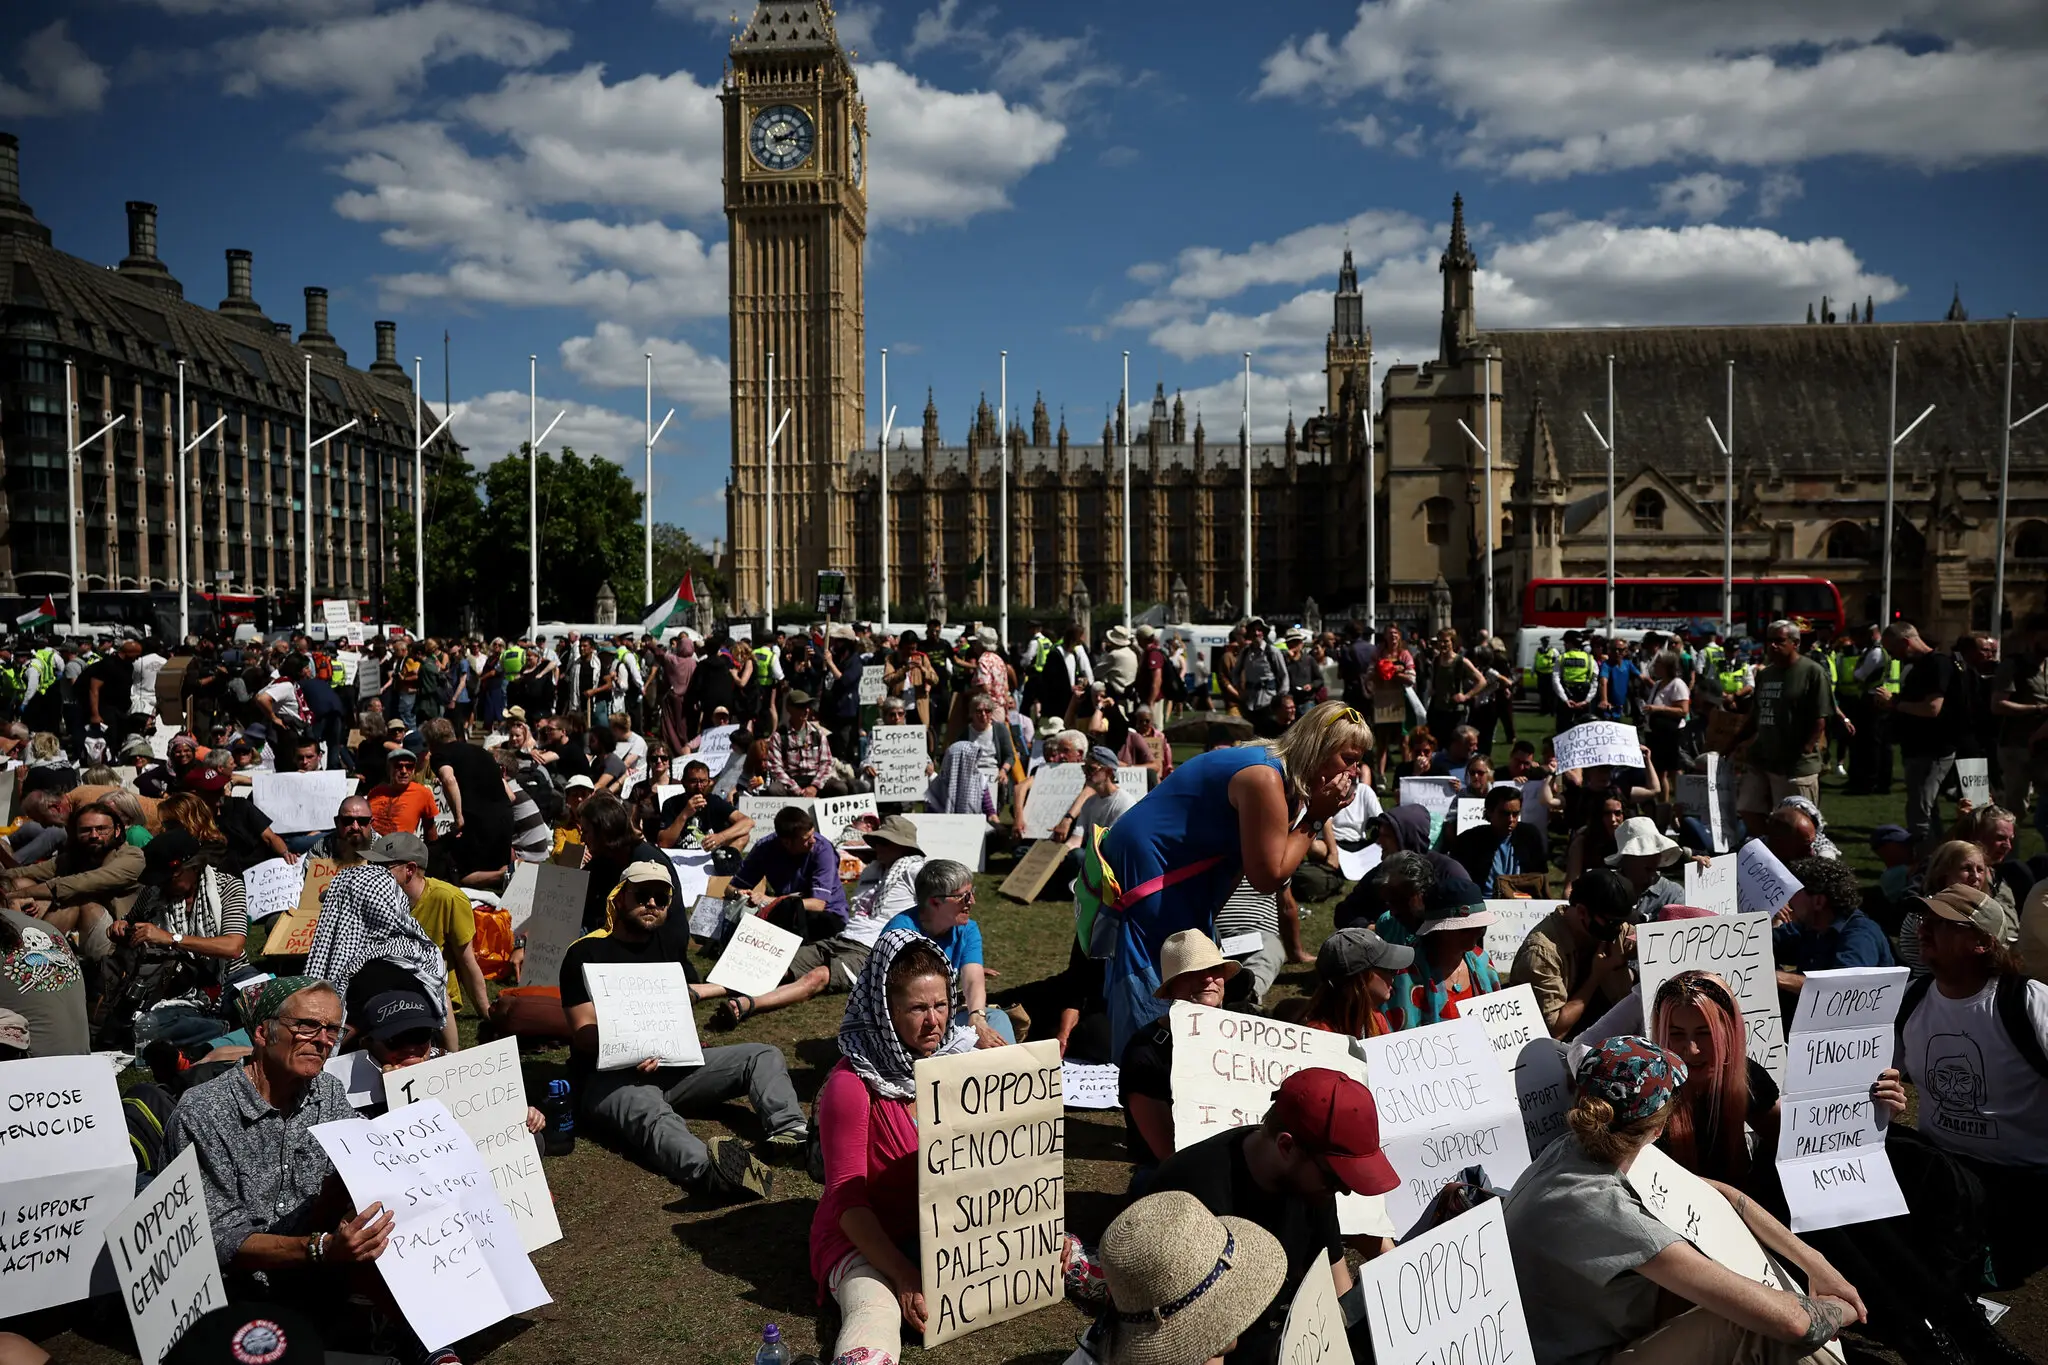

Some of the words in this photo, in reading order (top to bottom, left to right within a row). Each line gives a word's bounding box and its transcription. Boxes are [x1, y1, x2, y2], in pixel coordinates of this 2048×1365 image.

[873, 729, 882, 741] I
[885, 731, 925, 745] oppose
[873, 744, 919, 756] Genocide
[1568, 724, 1621, 741] OPPOSE
[872, 761, 884, 772] I
[889, 762, 923, 774] support
[876, 772, 921, 784] Palestine
[824, 802, 829, 817] I
[832, 798, 870, 814] OPPOSE
[880, 784, 917, 796] Action
[1741, 852, 1755, 867] I
[1747, 862, 1785, 907] OPPOSE
[737, 931, 786, 959] GENOCIDE
[1644, 932, 1665, 965] I
[1669, 918, 1768, 965] OPPOSE
[598, 974, 612, 998] I
[618, 976, 670, 998] OPPOSE
[1810, 990, 1820, 1019] I
[1826, 984, 1892, 1018] OPPOSE
[377, 1000, 425, 1023] Titleist
[620, 1000, 676, 1016] GENOCIDE
[1482, 999, 1523, 1024] OPPOSE
[612, 1018, 620, 1038] I
[632, 1019, 678, 1033] SUPPORT
[1188, 1012, 1204, 1037] I
[1219, 1018, 1313, 1054] OPPOSE
[1212, 1048, 1302, 1087] GENOC
[1385, 1033, 1472, 1076] OPPOSE
[1806, 1034, 1884, 1076] GENOCIDE
[400, 1078, 420, 1104] I
[426, 1052, 514, 1096] OPPOSE
[8, 1089, 83, 1112] OPPOSE
[931, 1079, 941, 1126] I
[960, 1066, 1063, 1116] OPPOSE
[1375, 1073, 1491, 1125] GENOCIDE
[1199, 1105, 1217, 1125] I
[1228, 1108, 1265, 1127] SU
[1792, 1107, 1797, 1132] I
[1809, 1099, 1874, 1128] SUPPORT
[340, 1138, 352, 1155] I
[366, 1113, 447, 1148] OPPOSE
[927, 1116, 1065, 1177] GENOCIDE
[1421, 1126, 1502, 1168] SUPPORT
[1796, 1128, 1866, 1158] PALESTINE
[373, 1138, 460, 1173] GENOCIDE
[404, 1171, 479, 1207] SUPPORT
[1812, 1159, 1867, 1191] ACTION
[1, 1210, 6, 1227] I
[17, 1195, 95, 1224] SUPPORT
[119, 1235, 133, 1273] I
[133, 1172, 195, 1255] OPPOSE
[932, 1203, 940, 1239] I
[953, 1175, 1064, 1234] SUPPORT
[391, 1207, 496, 1260] PALESTINE
[2, 1245, 71, 1276] ACTION
[131, 1211, 203, 1317] GENOCIDE
[432, 1231, 496, 1276] ACTION
[936, 1217, 1065, 1290] PALESTINE
[937, 1264, 1055, 1336] ACTION
[1377, 1280, 1395, 1348] I
[1399, 1221, 1493, 1335] OPPOSE
[171, 1298, 178, 1318] I
